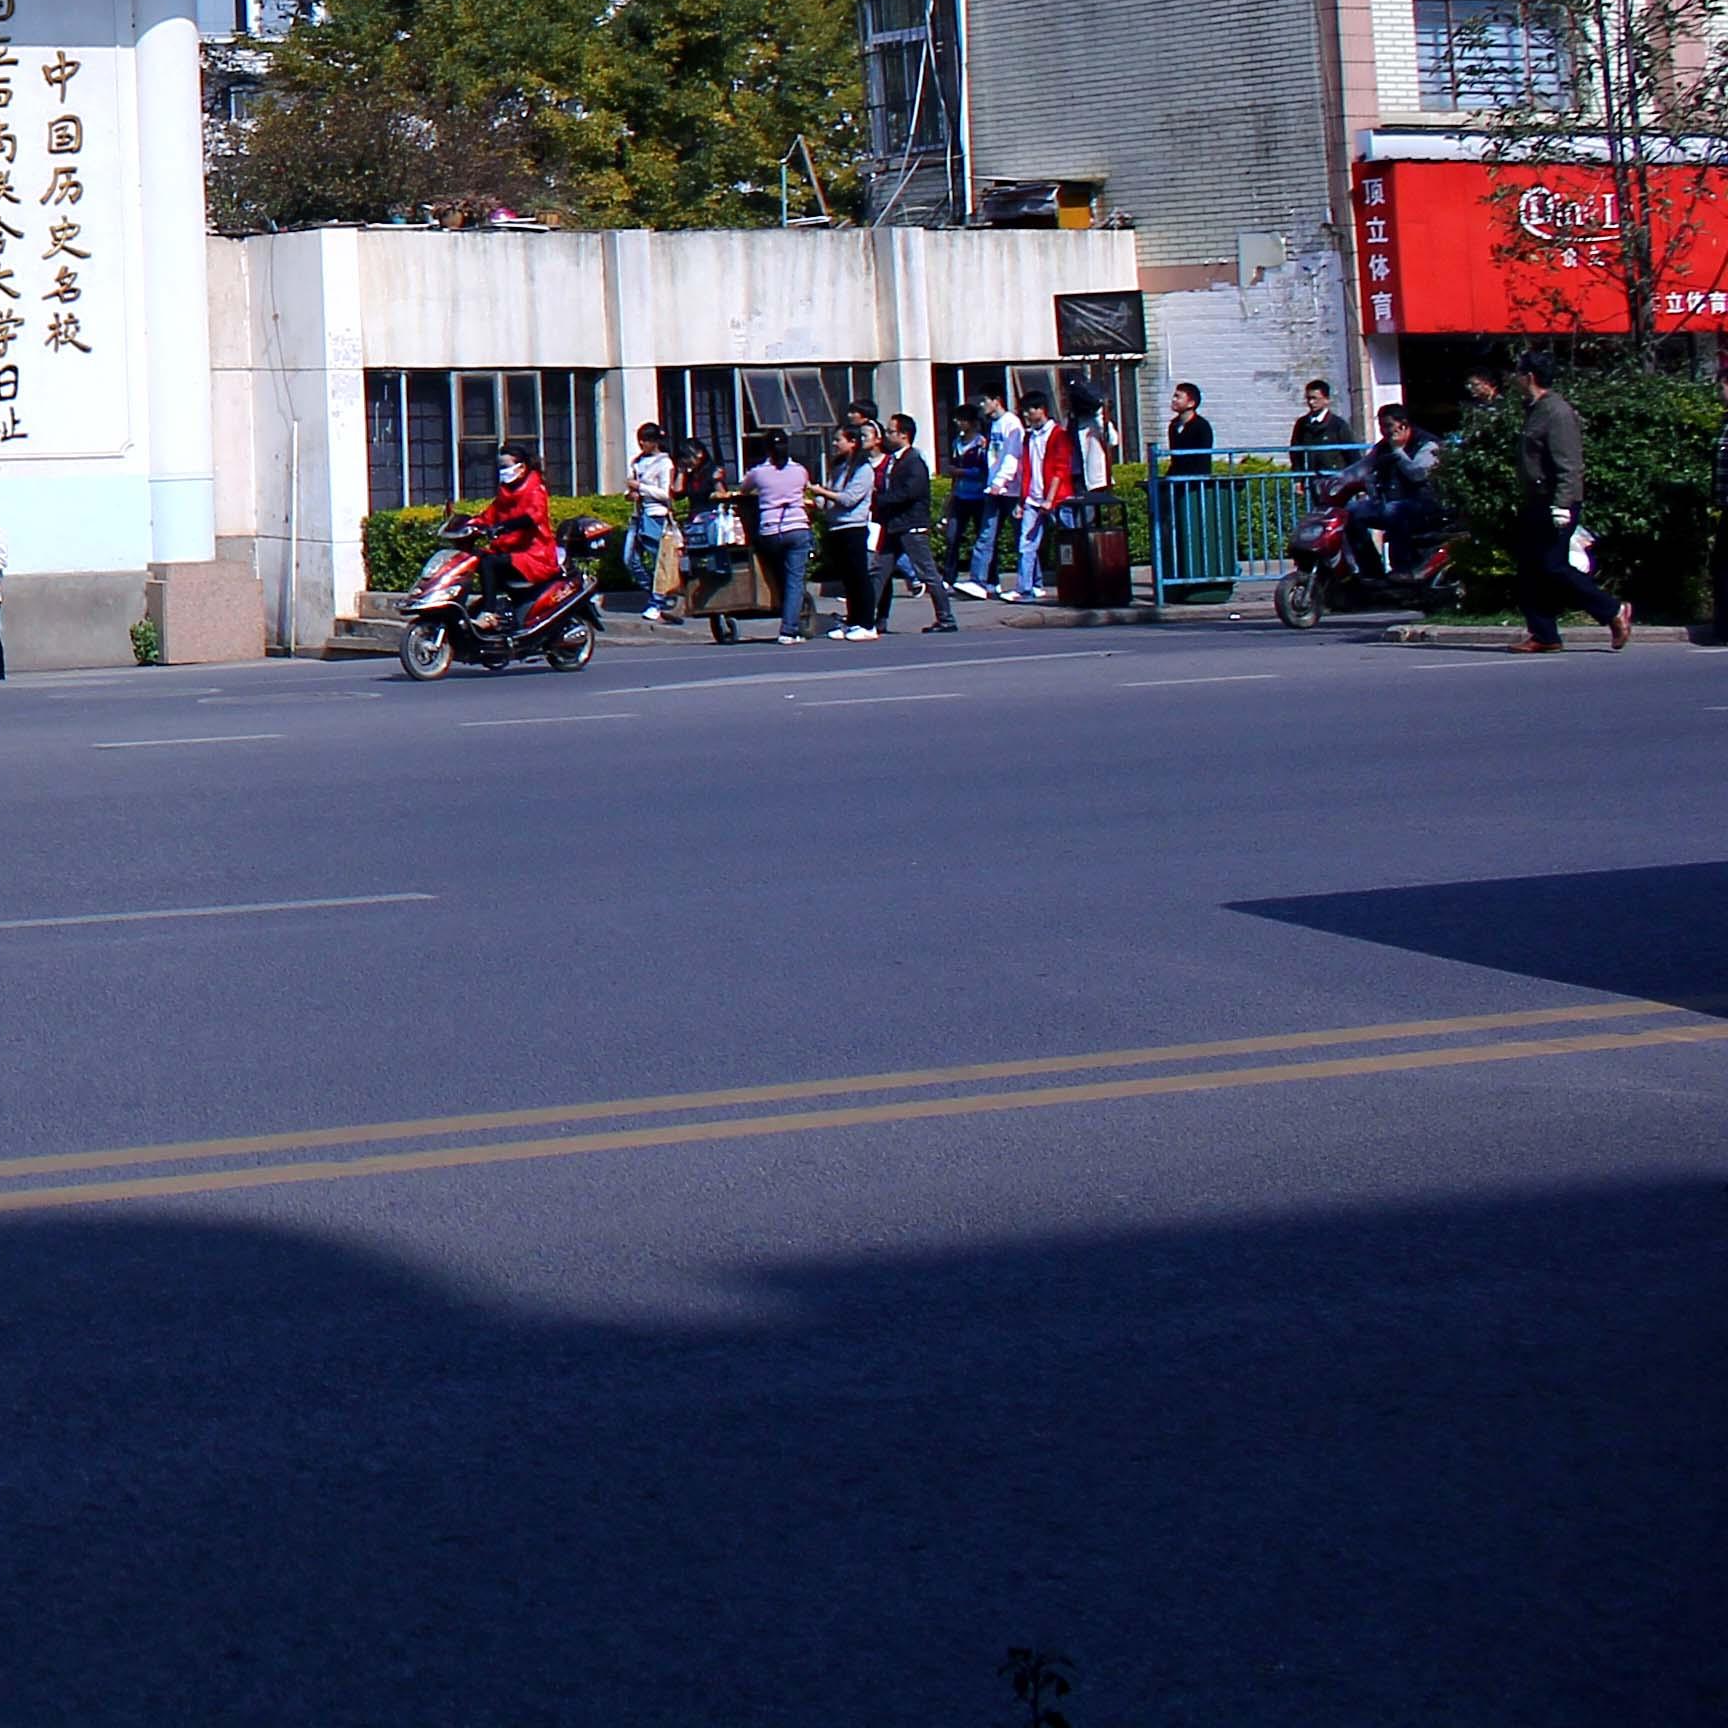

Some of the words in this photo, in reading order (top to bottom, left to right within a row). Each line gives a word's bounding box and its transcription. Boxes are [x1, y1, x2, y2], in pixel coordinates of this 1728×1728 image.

[40, 50, 92, 354] 中国历史名校
[1361, 177, 1394, 322] 顶立体育
